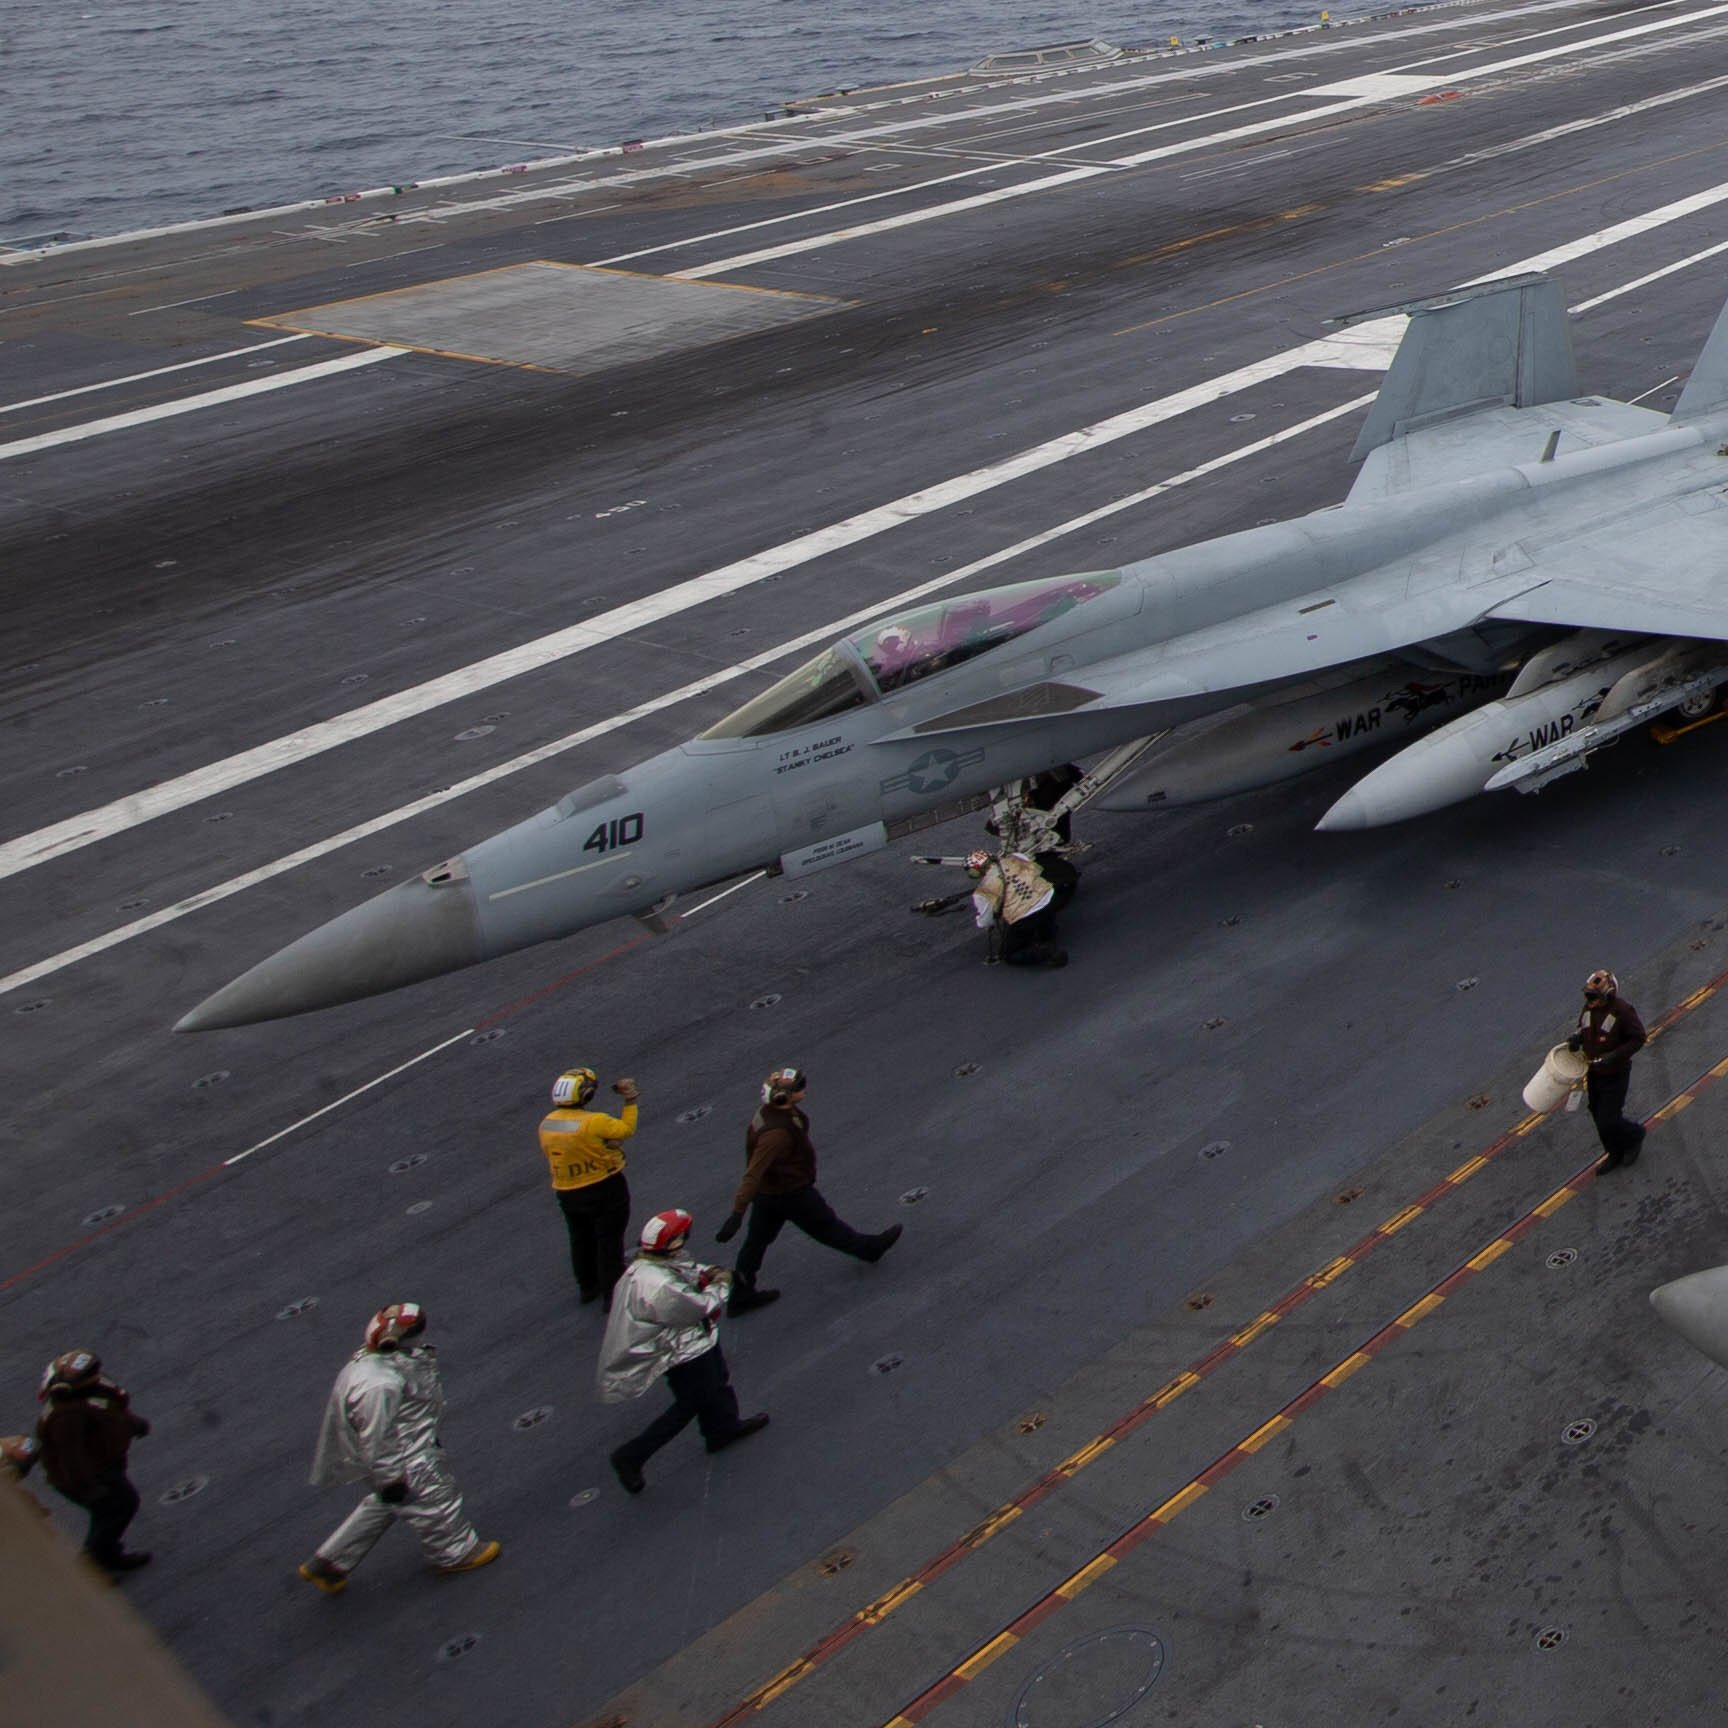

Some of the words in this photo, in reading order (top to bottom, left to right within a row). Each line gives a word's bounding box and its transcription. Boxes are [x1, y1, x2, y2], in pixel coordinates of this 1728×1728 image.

[1335, 707, 1382, 742] WAR
[1529, 713, 1575, 751] WAR
[583, 812, 644, 854] 410
